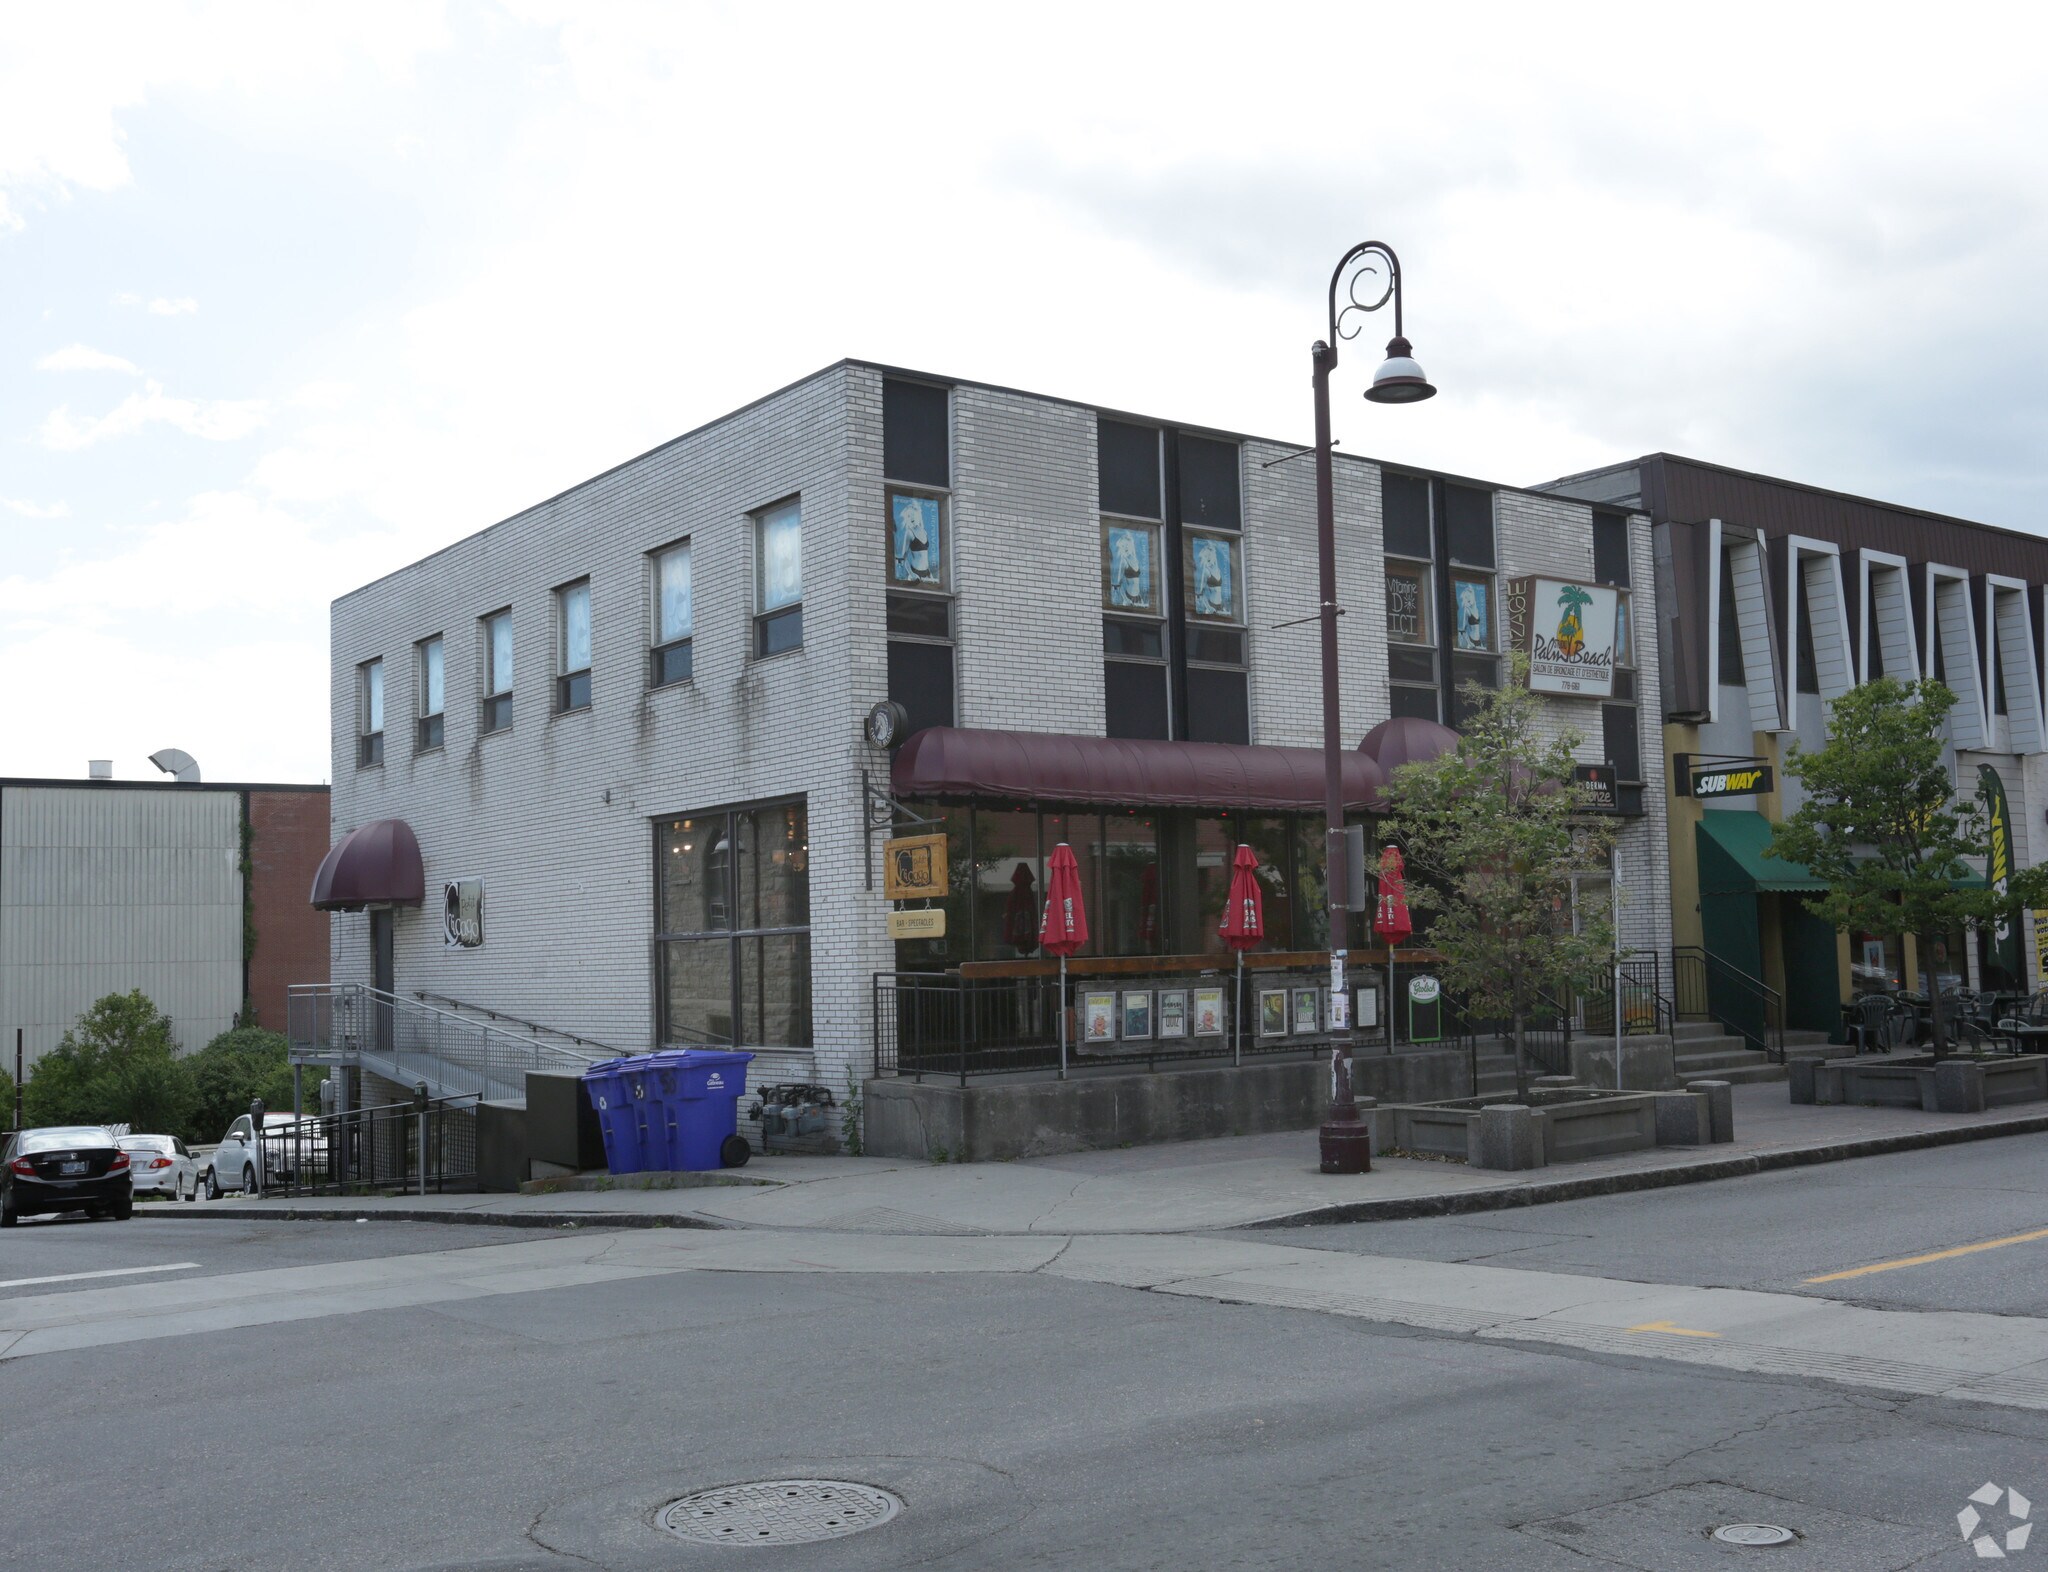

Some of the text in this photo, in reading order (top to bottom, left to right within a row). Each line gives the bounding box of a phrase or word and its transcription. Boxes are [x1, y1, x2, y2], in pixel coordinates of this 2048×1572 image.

[1387, 577, 1418, 598] Vitamine
[1391, 592, 1403, 612] D
[1388, 612, 1418, 636] ICI
[1507, 580, 1528, 655] NZAGE
[1533, 633, 1612, 667] Palm Beach
[1532, 663, 1547, 673] SALON
[1547, 665, 1553, 674] DE
[1553, 666, 1576, 677] BRONZAGE
[1576, 668, 1581, 677] ET
[1585, 781, 1607, 790] DERMA
[1696, 770, 1762, 794] SUBWAY
[896, 918, 934, 928] BAR SPECTACLES
